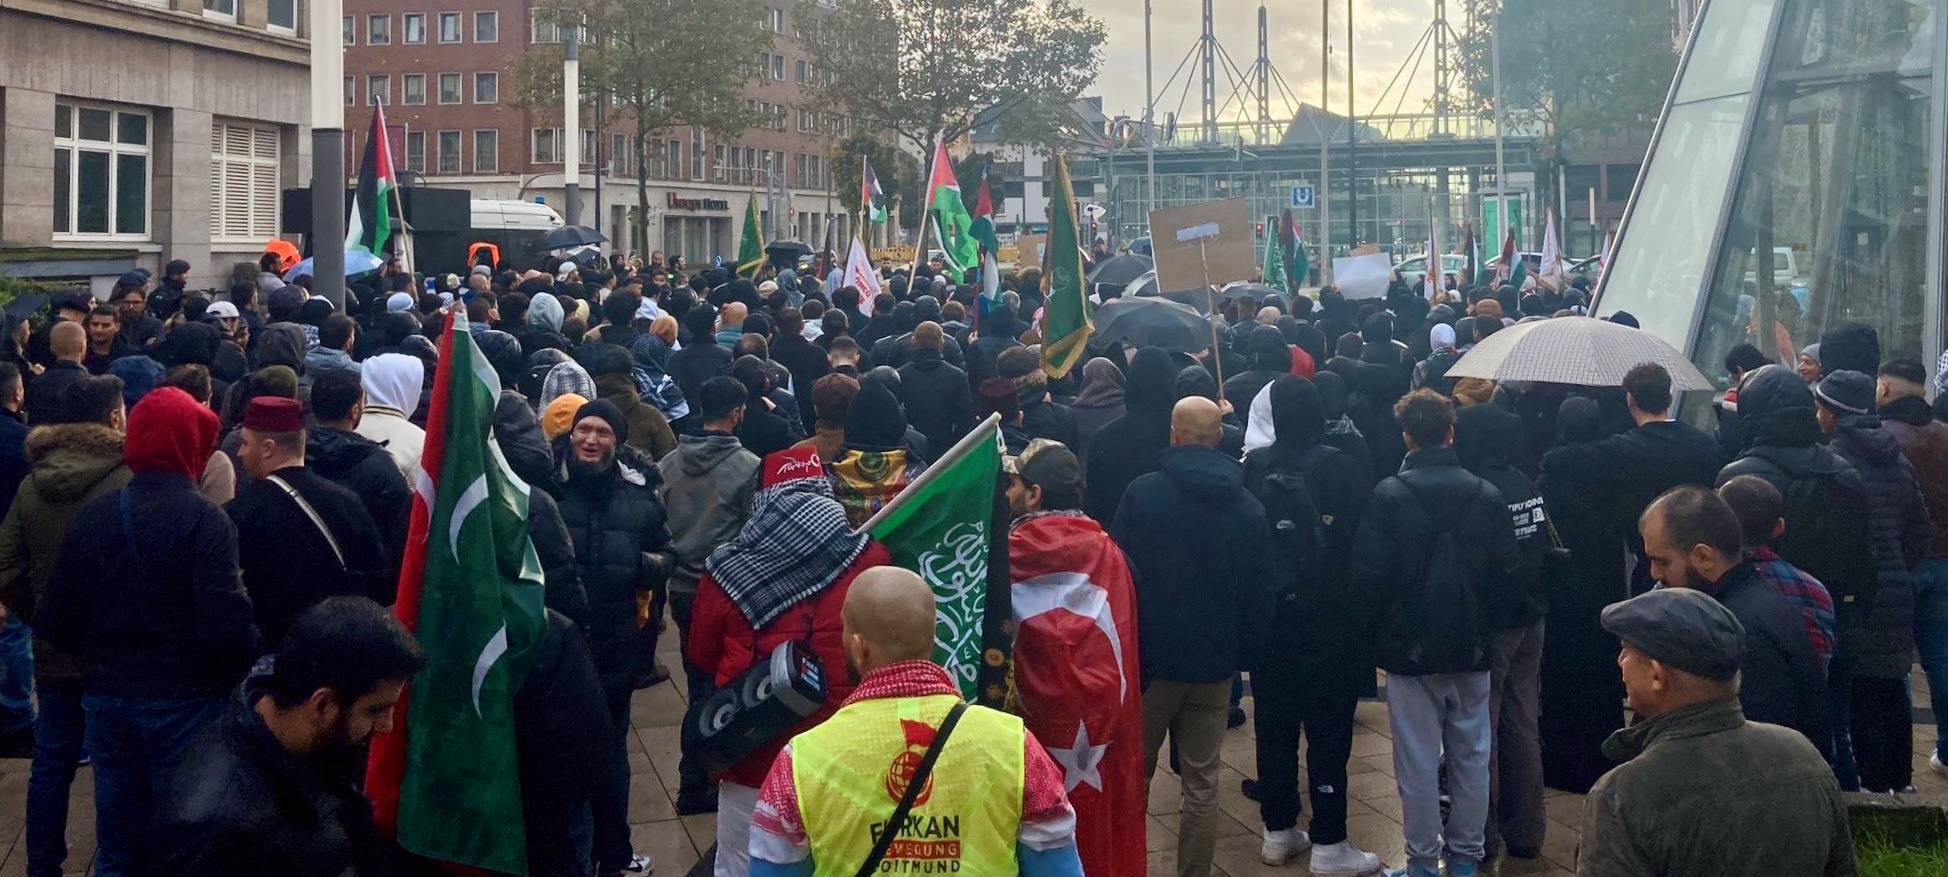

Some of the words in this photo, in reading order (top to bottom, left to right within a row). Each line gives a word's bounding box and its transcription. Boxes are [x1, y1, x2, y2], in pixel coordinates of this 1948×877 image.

[869, 815, 960, 845] FRKAN
[882, 841, 958, 857] EWEGUNG
[880, 859, 960, 873] OTMUND
